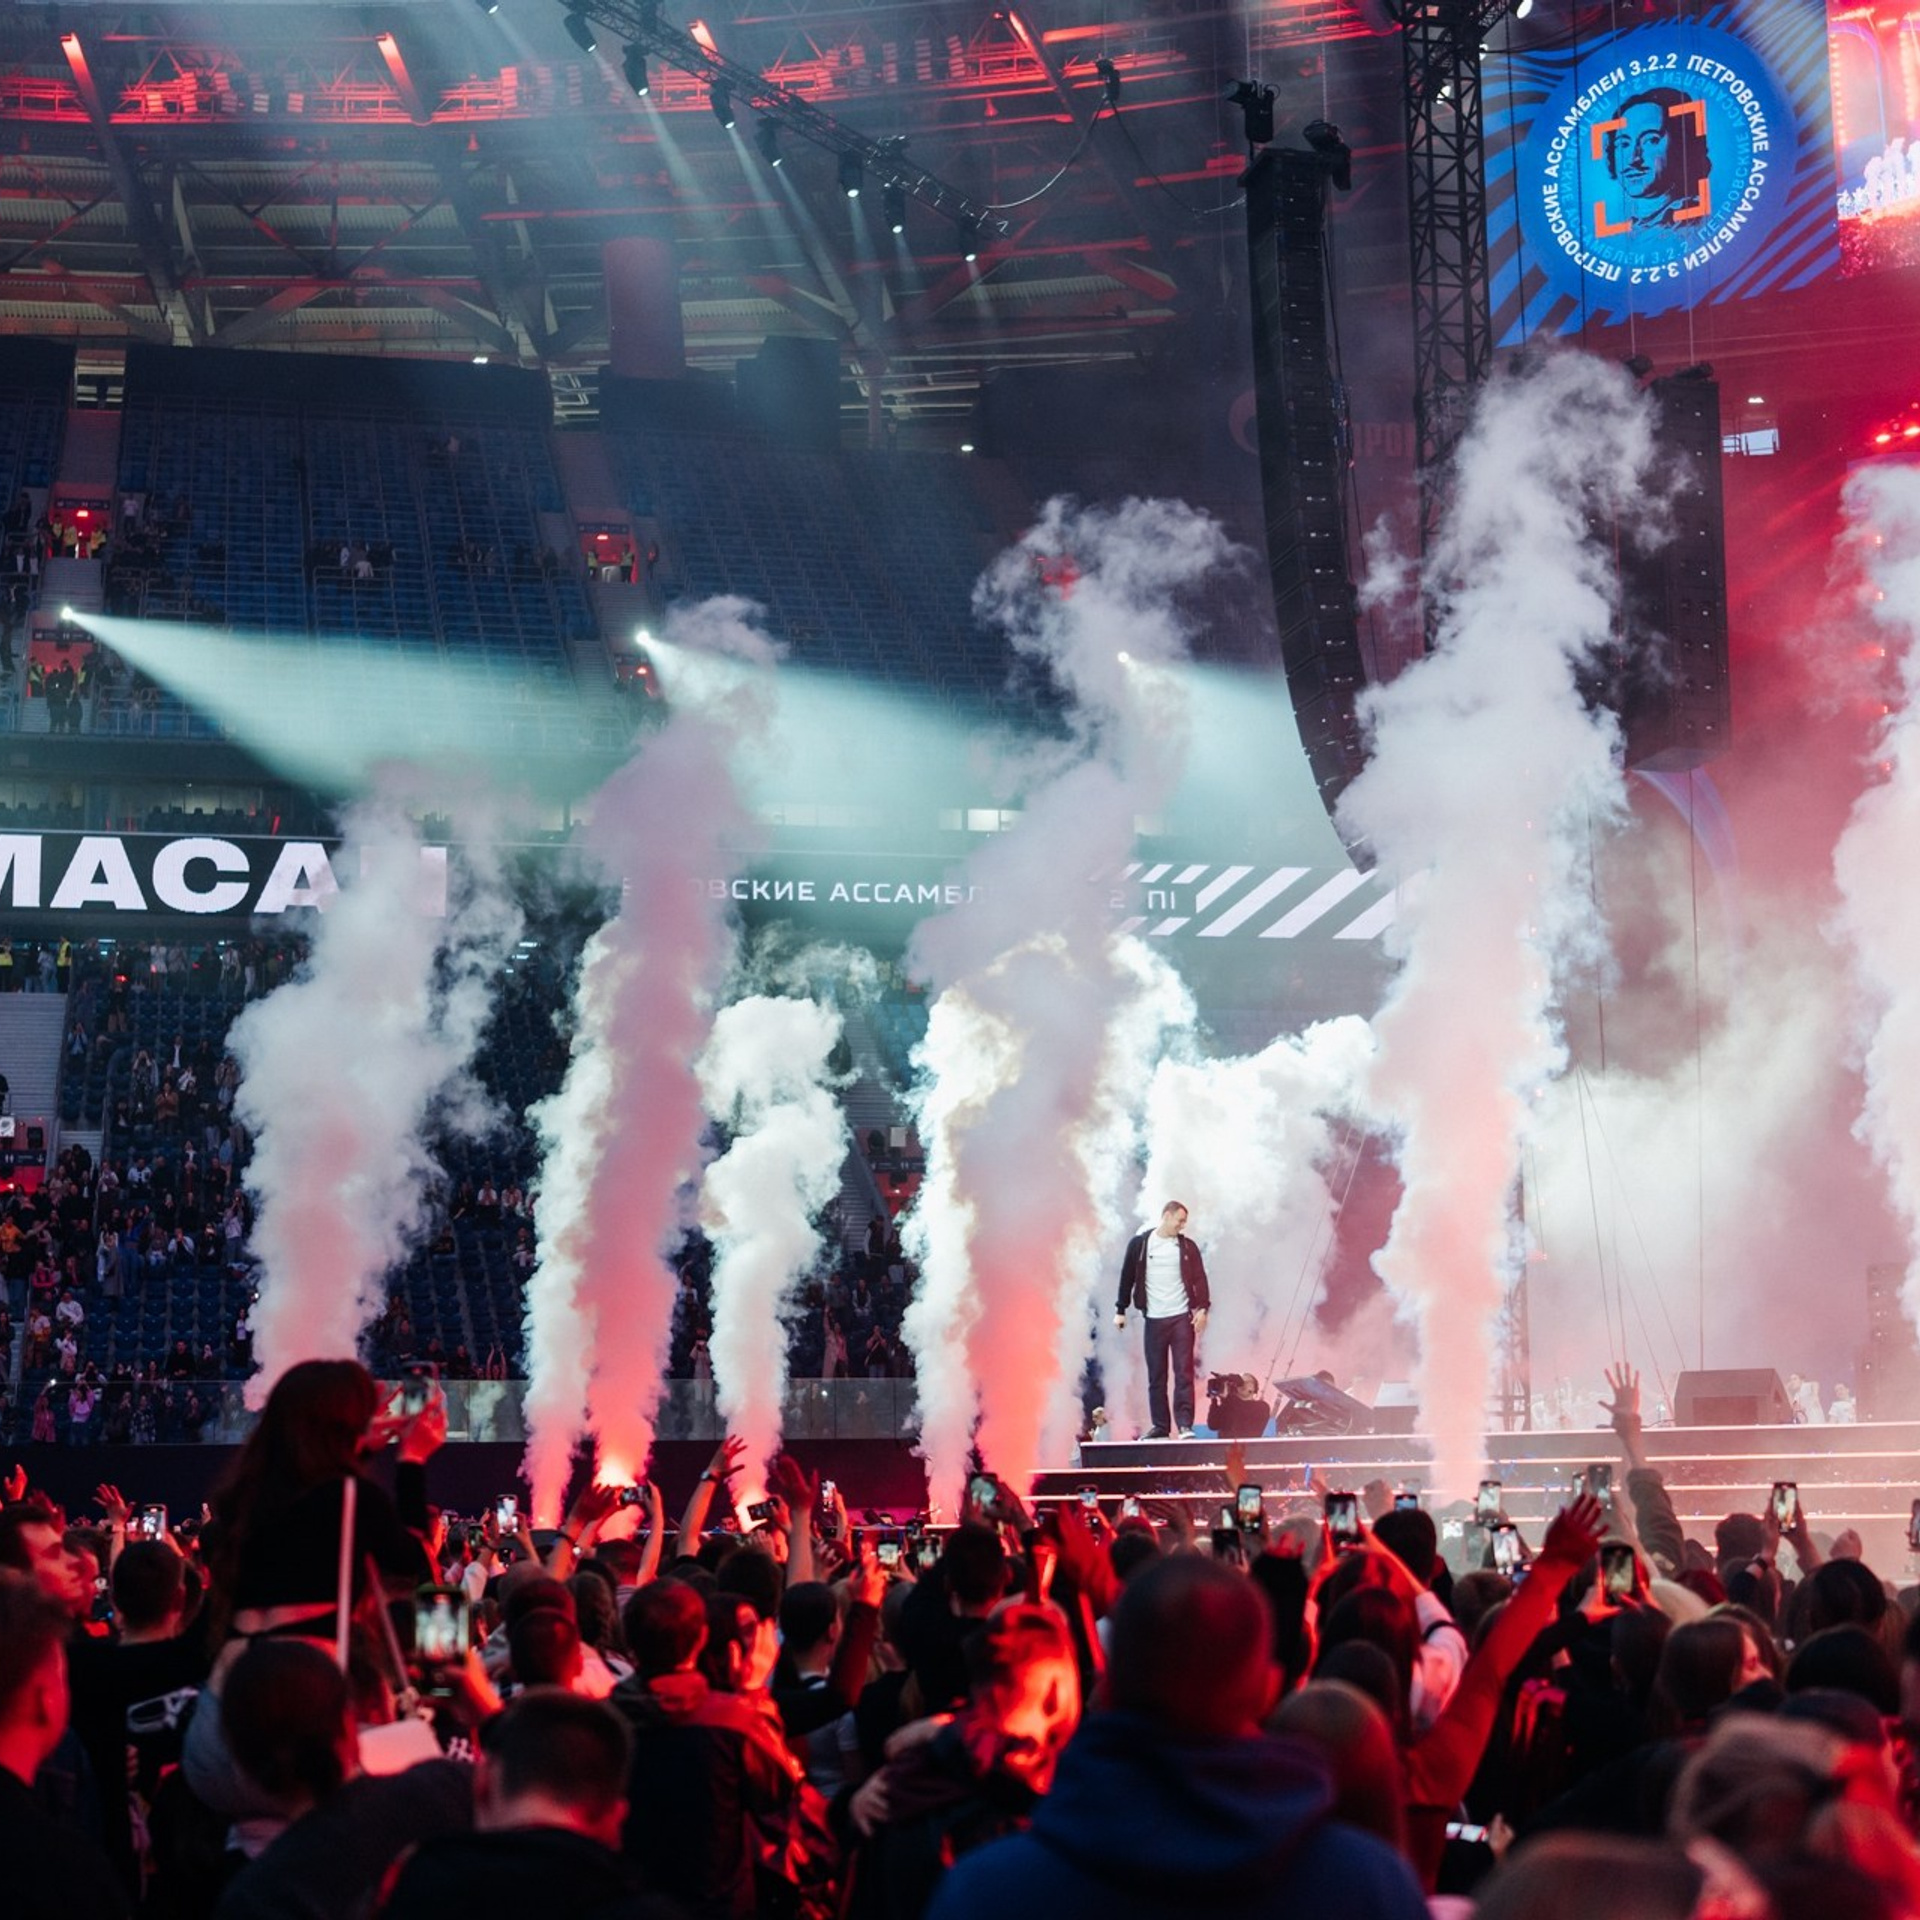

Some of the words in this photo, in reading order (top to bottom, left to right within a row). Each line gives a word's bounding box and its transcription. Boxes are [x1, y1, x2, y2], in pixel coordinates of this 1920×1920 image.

[1629, 53, 1678, 76] 3.2.2
[1686, 54, 1768, 153] ПЕТРОВСКИЕ
[1545, 67, 1625, 177] АССАМБЛЕИ
[1543, 183, 1621, 281] ПЕТРОВСКИЕ
[1683, 158, 1768, 271] АССАМБЛЕИ
[1630, 260, 1679, 283] 3.2.2
